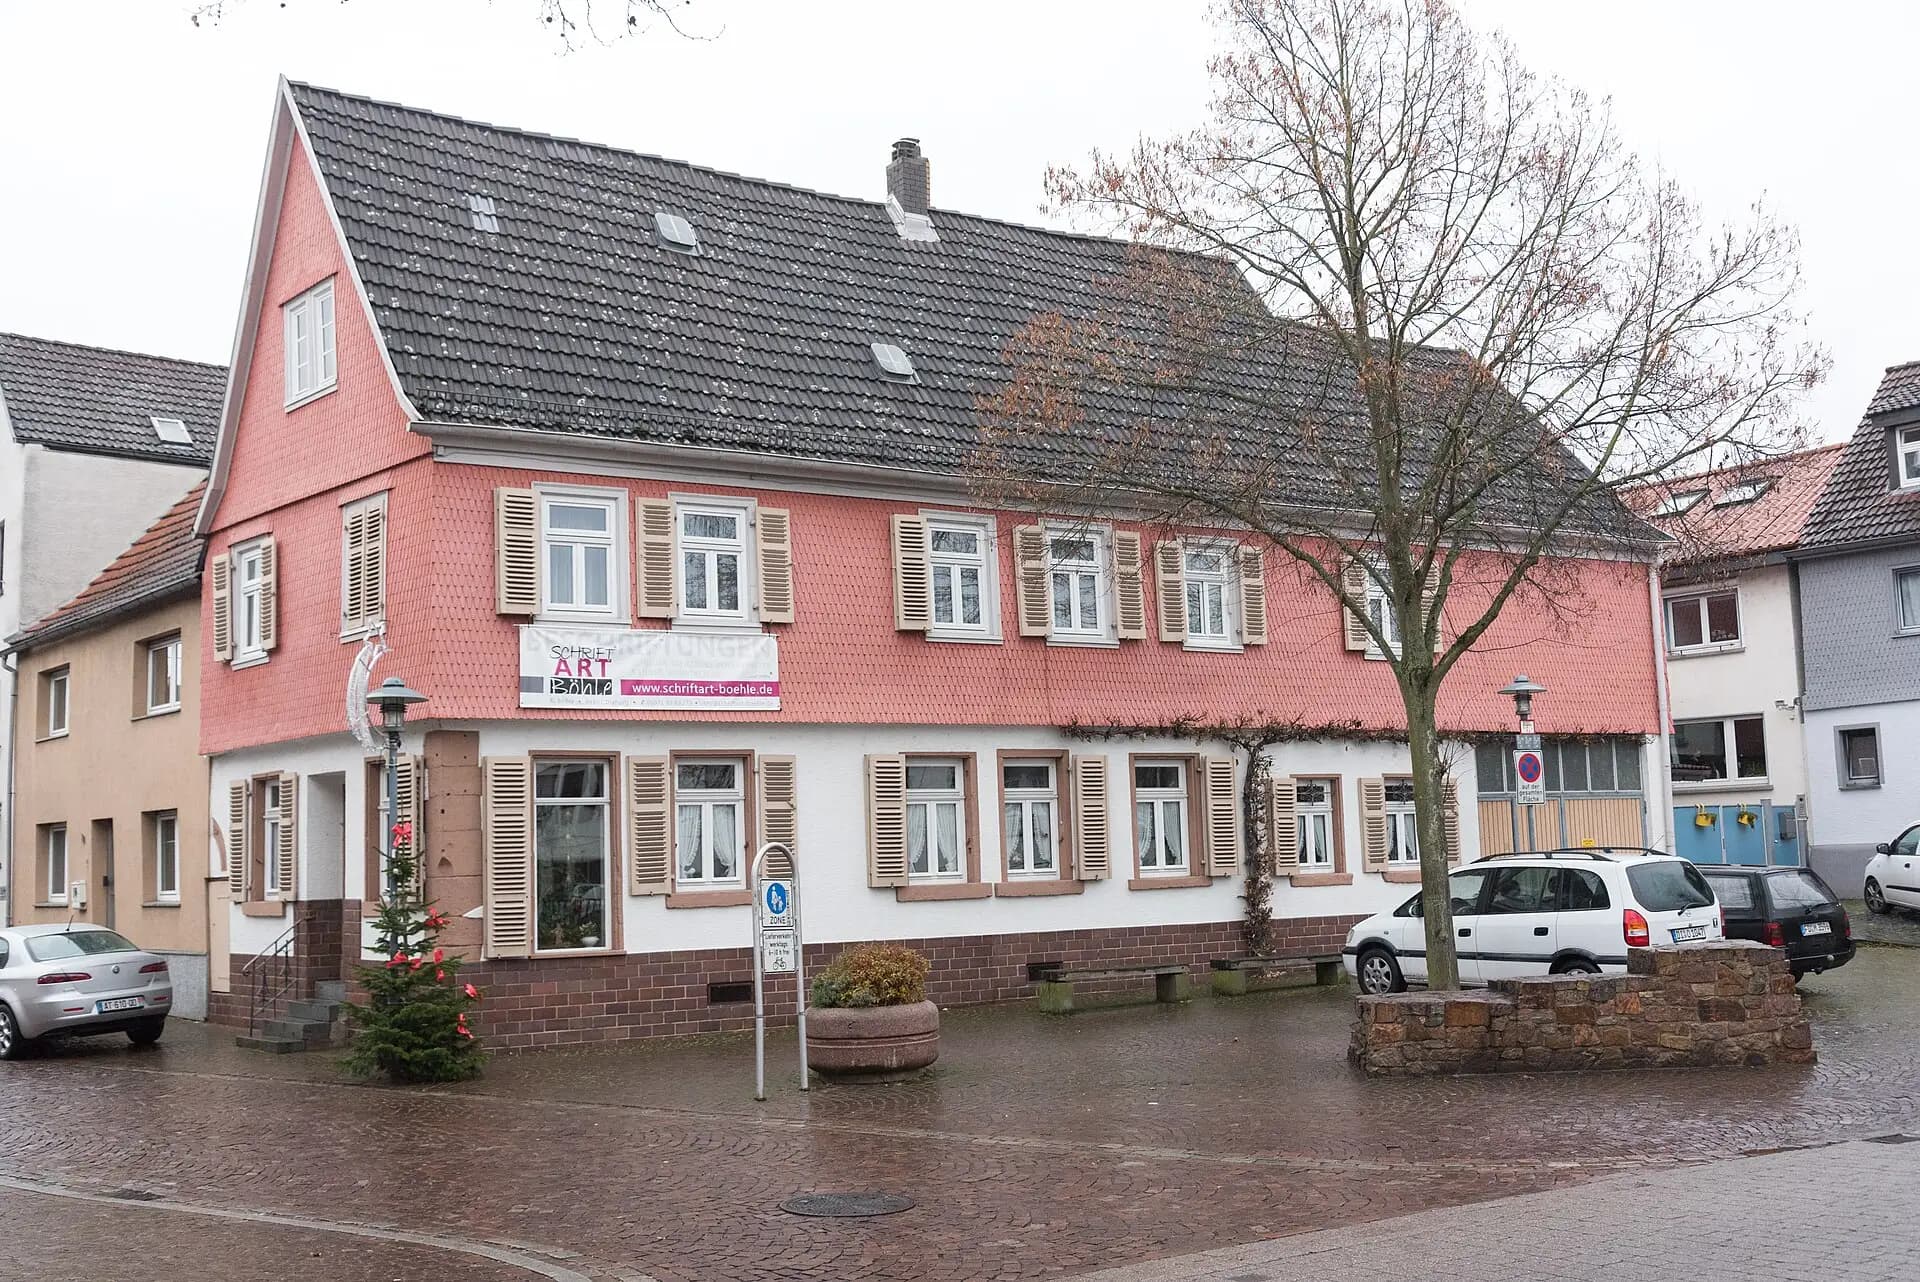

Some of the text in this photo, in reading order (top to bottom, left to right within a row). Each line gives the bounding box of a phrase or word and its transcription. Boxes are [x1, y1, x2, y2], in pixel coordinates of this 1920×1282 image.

[554, 658, 612, 677] ART
[550, 677, 612, 696] Böhle
[631, 681, 774, 695] www.schriftart-boehle.de
[770, 916, 786, 924] ZONE
